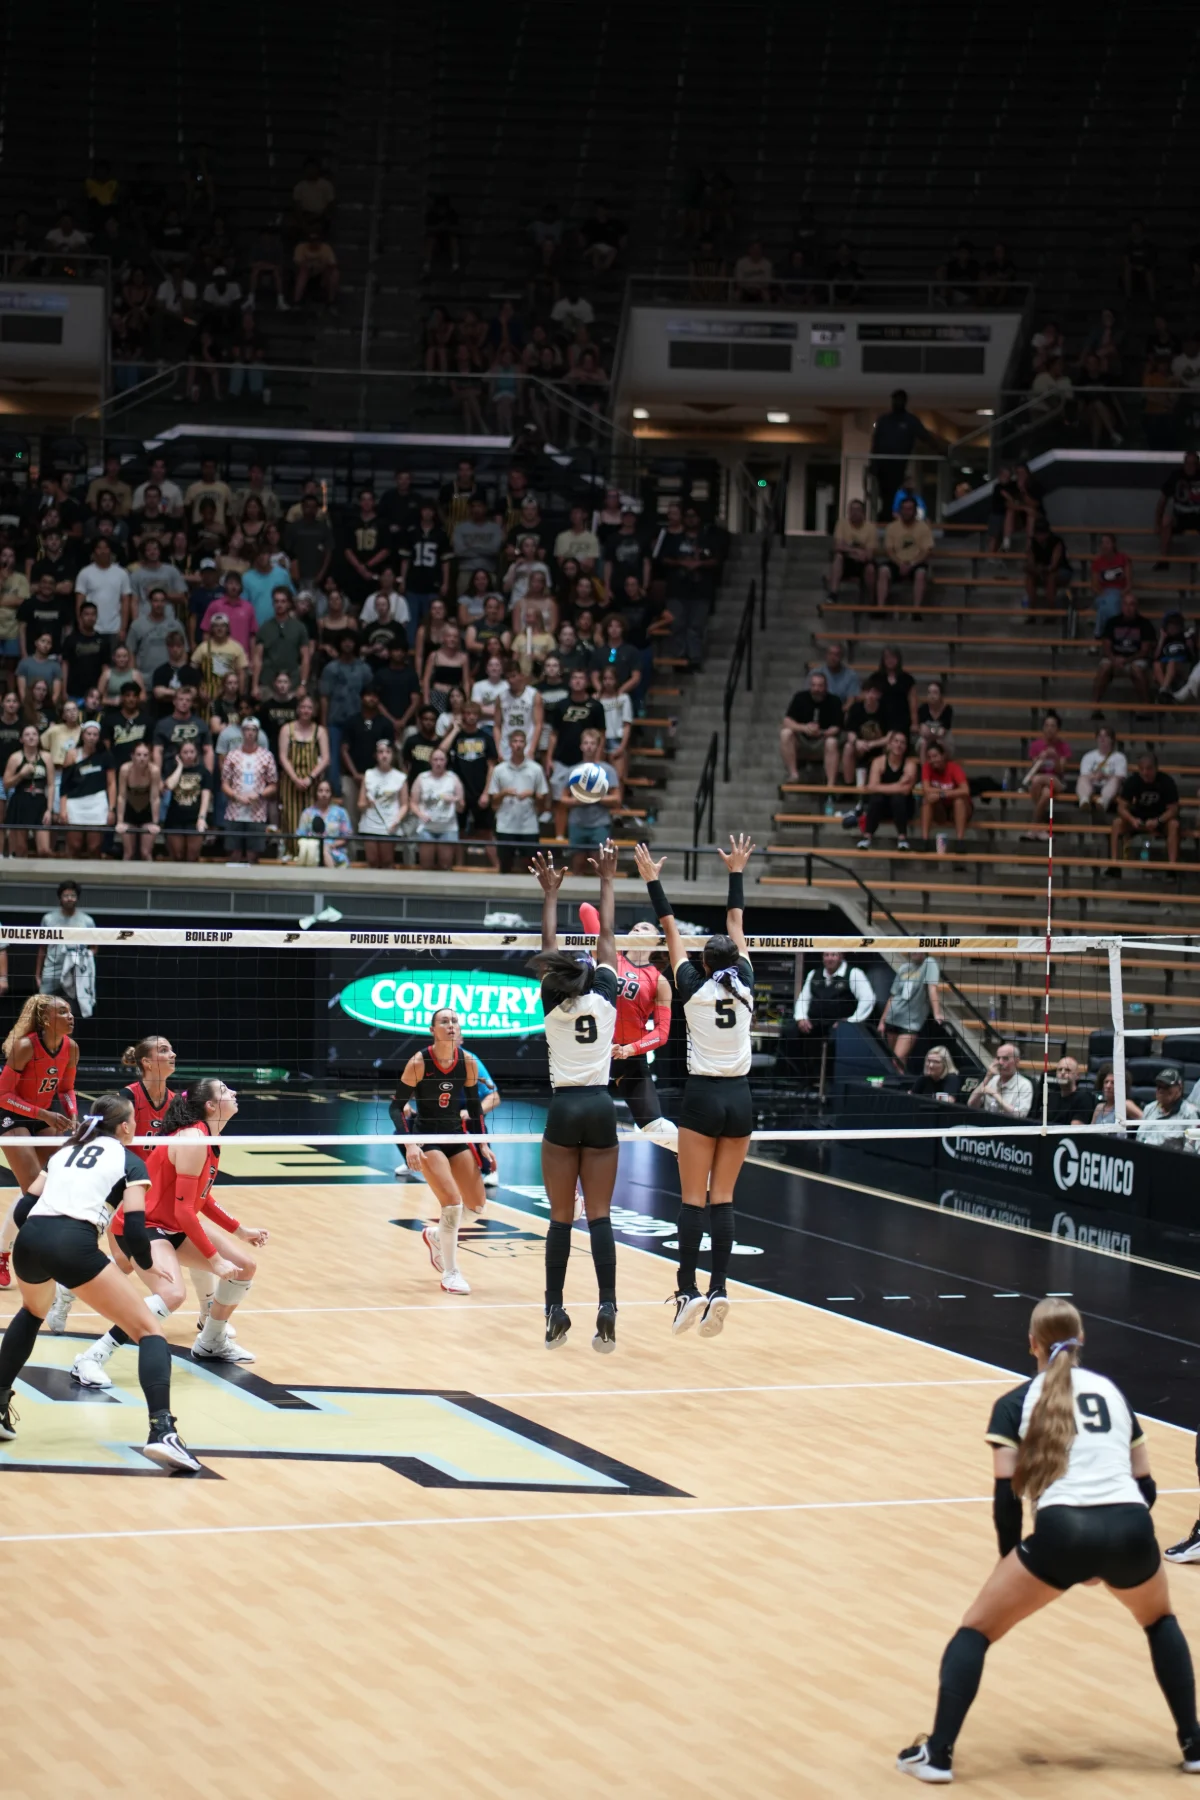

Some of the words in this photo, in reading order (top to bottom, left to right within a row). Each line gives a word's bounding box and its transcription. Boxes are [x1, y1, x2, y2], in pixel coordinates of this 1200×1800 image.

[414, 542, 438, 567] 15
[1, 928, 65, 940] VOLLEYBALL
[185, 931, 218, 942] BOILER
[220, 932, 233, 942] UP
[350, 933, 389, 944] PURDUE
[394, 933, 453, 945] VOLLEYBALL
[565, 935, 596, 946] BOILER
[760, 937, 814, 949] VOLLEYBALL
[919, 938, 948, 948] BOILER
[949, 939, 960, 948] UP
[371, 979, 541, 1014] COUNTRY
[715, 999, 736, 1029] 5
[575, 1014, 598, 1044] 9
[38, 1077, 60, 1094] 13
[64, 1145, 105, 1169] 18
[955, 1136, 1033, 1167] InnerVision
[1080, 1151, 1135, 1197] GEMCO
